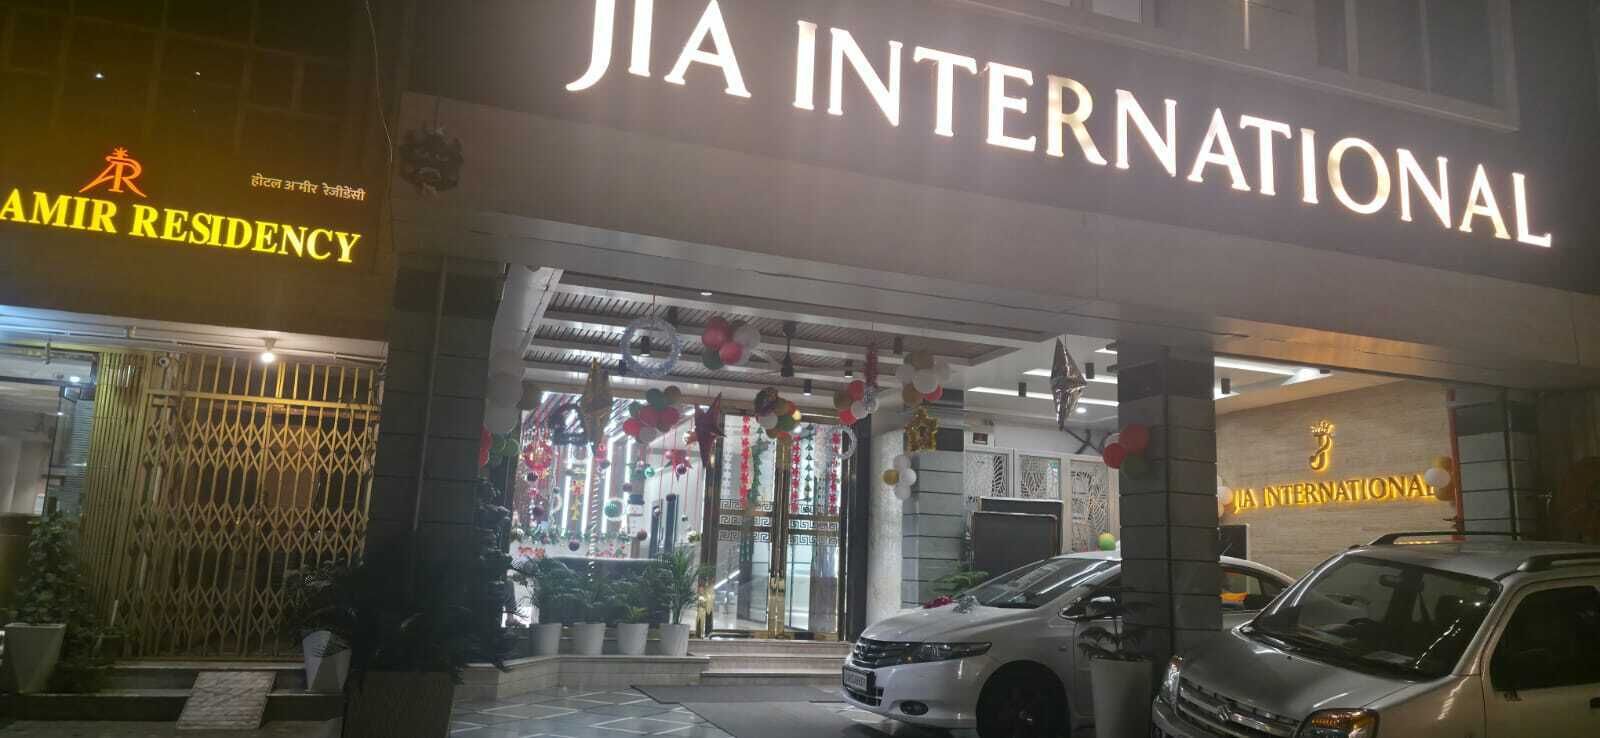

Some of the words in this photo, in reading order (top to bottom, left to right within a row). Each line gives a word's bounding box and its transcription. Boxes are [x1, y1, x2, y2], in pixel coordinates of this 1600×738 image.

[565, 0, 752, 97] JIA
[792, 19, 1553, 249] INTERNATIONAL
[251, 172, 282, 189] होटल
[0, 188, 118, 234] AMIR
[128, 203, 361, 264] RESIDENCY
[1232, 486, 1258, 514] JIA
